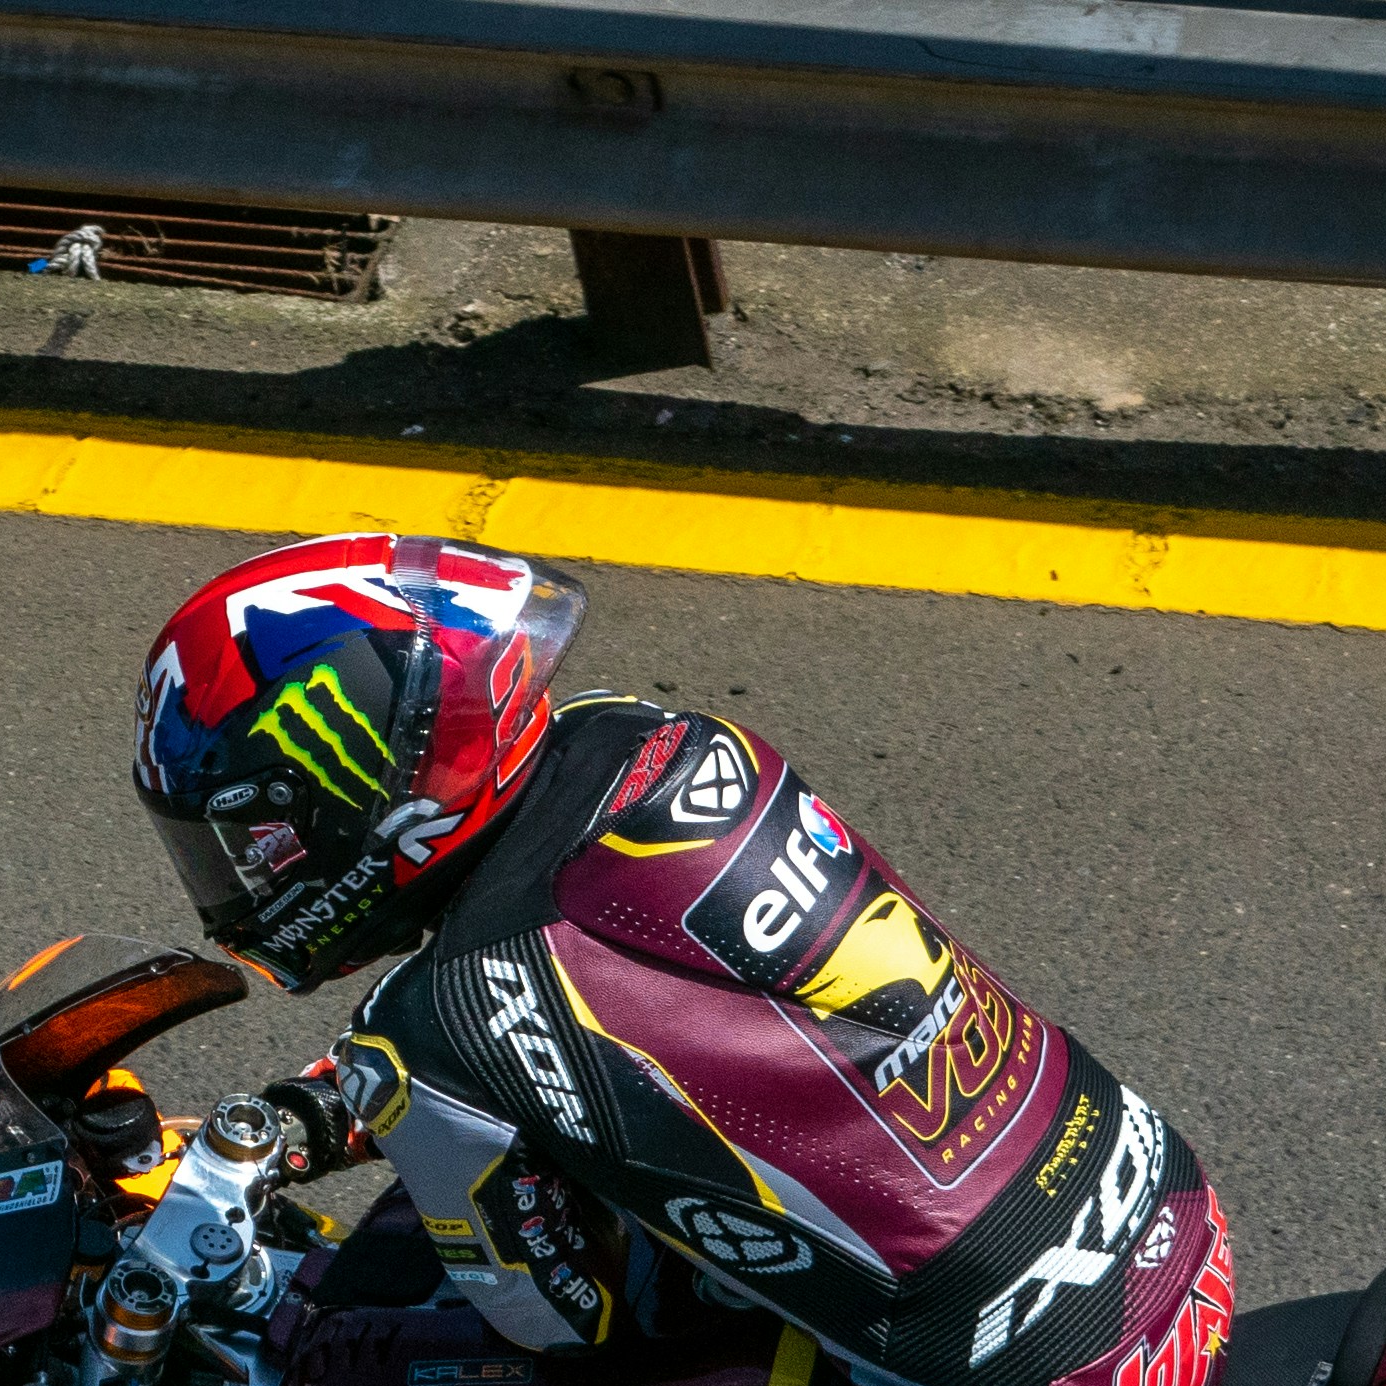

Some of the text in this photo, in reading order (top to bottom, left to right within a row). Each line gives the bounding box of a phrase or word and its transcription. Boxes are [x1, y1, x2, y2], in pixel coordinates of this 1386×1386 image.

[216, 786, 256, 807] HJC
[262, 853, 389, 953] MONSTER
[305, 883, 383, 955] ENERGY
[742, 827, 830, 953] elf
[481, 956, 596, 1145] IXON
[874, 975, 965, 1092] marc
[941, 1013, 1034, 1165] RACING TEAM
[412, 1363, 526, 1382] KALEX
